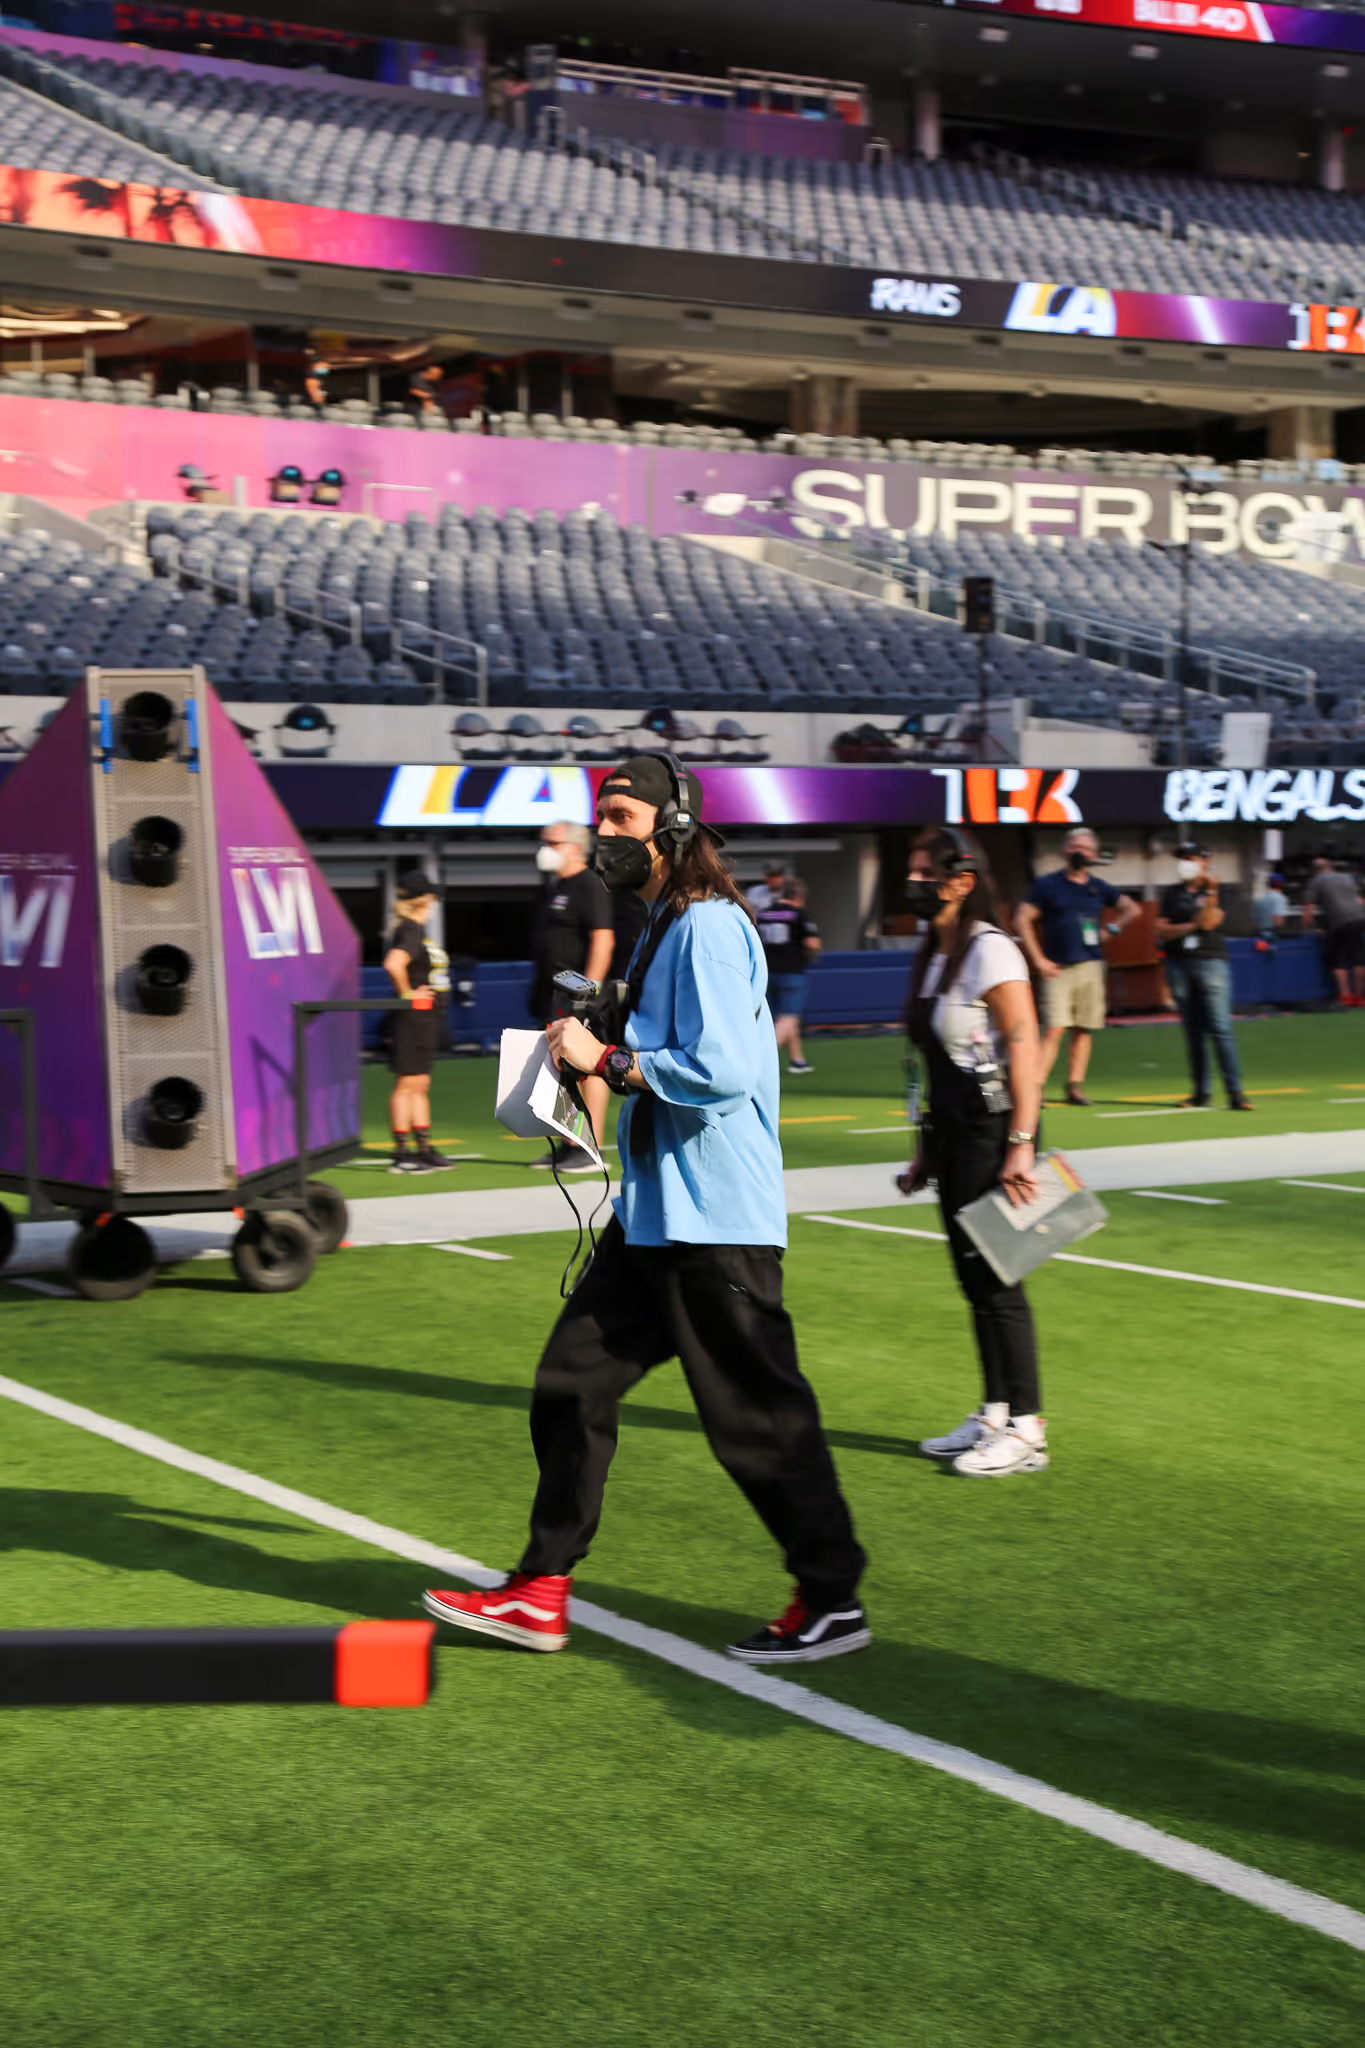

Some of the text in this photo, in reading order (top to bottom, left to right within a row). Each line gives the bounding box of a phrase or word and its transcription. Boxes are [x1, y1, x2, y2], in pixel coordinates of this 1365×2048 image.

[870, 278, 962, 317] RAMS
[790, 469, 1153, 548] SUPER
[375, 765, 593, 826] LA
[1163, 768, 1365, 821] BENGALS
[230, 867, 324, 959] LVI
